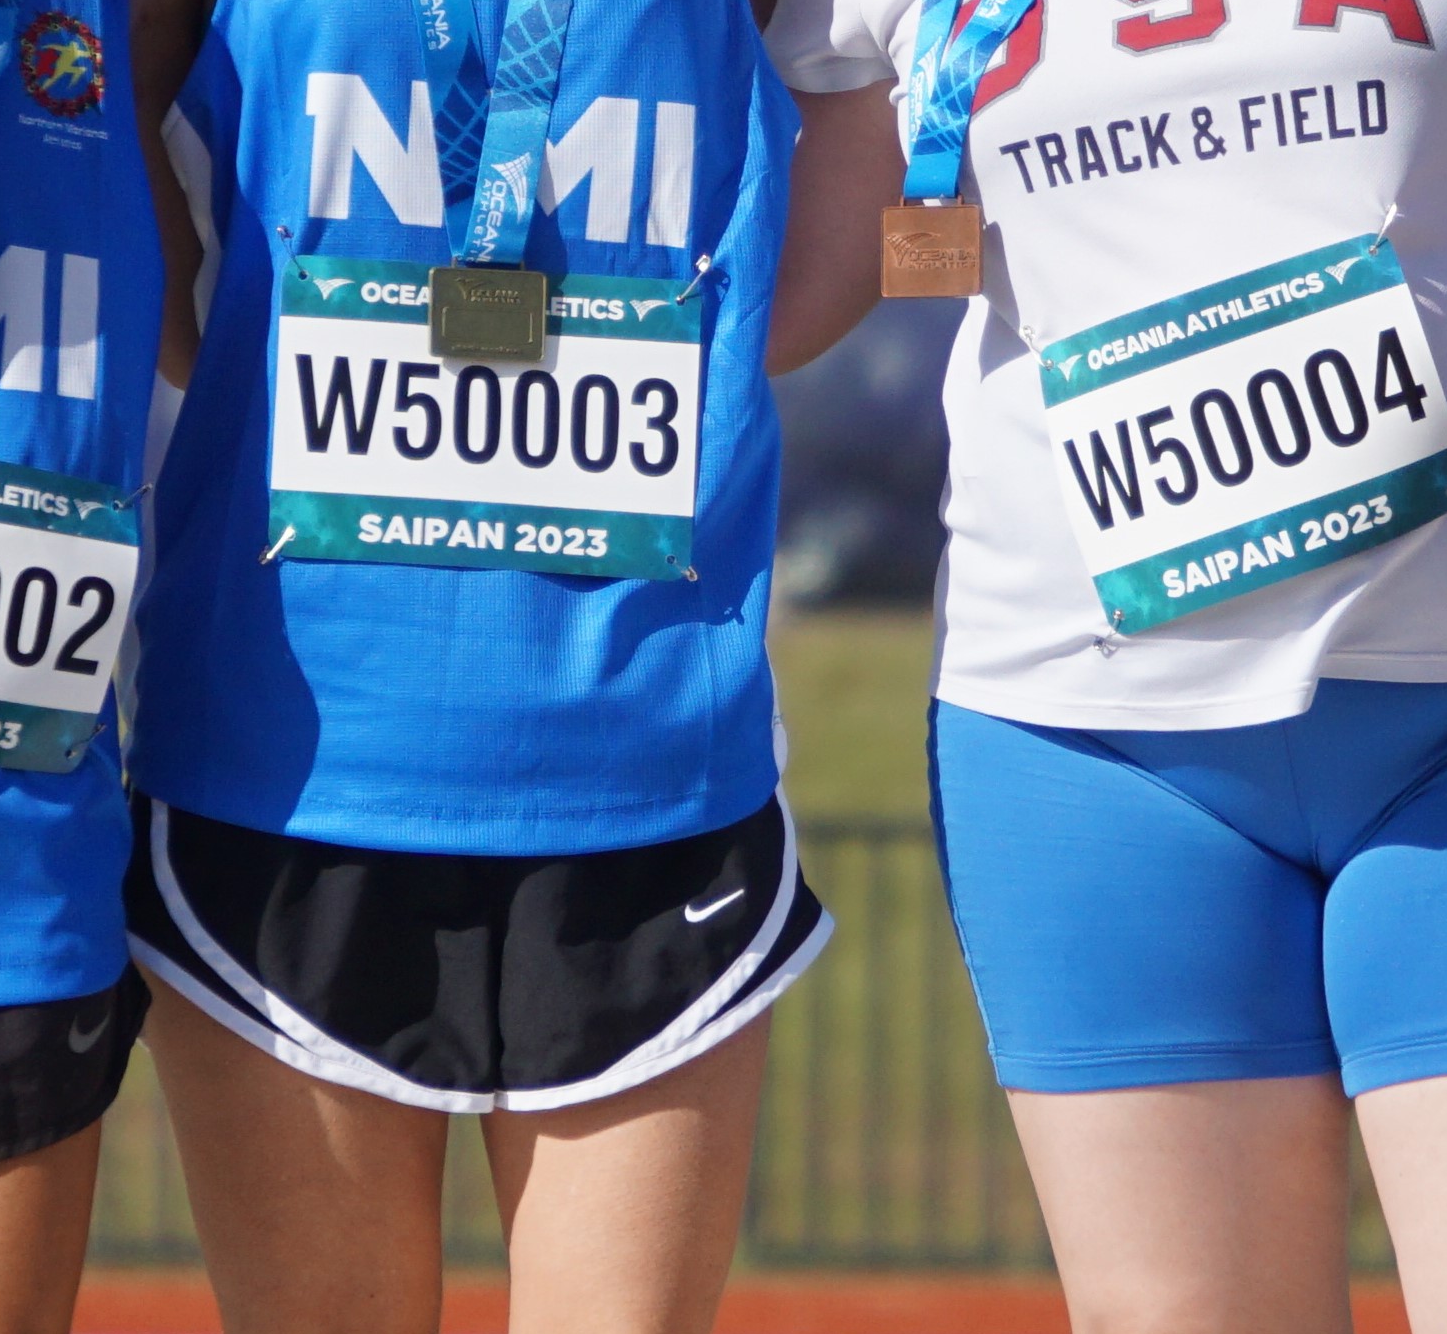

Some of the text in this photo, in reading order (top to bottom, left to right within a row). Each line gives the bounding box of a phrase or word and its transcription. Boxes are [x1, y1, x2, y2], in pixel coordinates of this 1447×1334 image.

[305, 72, 695, 249] NMI
[999, 79, 1388, 194] TRACK & FIELD
[476, 180, 507, 263] OCEANI
[360, 281, 431, 306] OCEA
[1088, 273, 1325, 371] OCEANIA ATHLETICS
[295, 353, 679, 477] W50003
[1062, 326, 1428, 532] W50004
[358, 513, 608, 557] SAIPAN 2023
[1162, 495, 1393, 598] SAIPAN 2023
